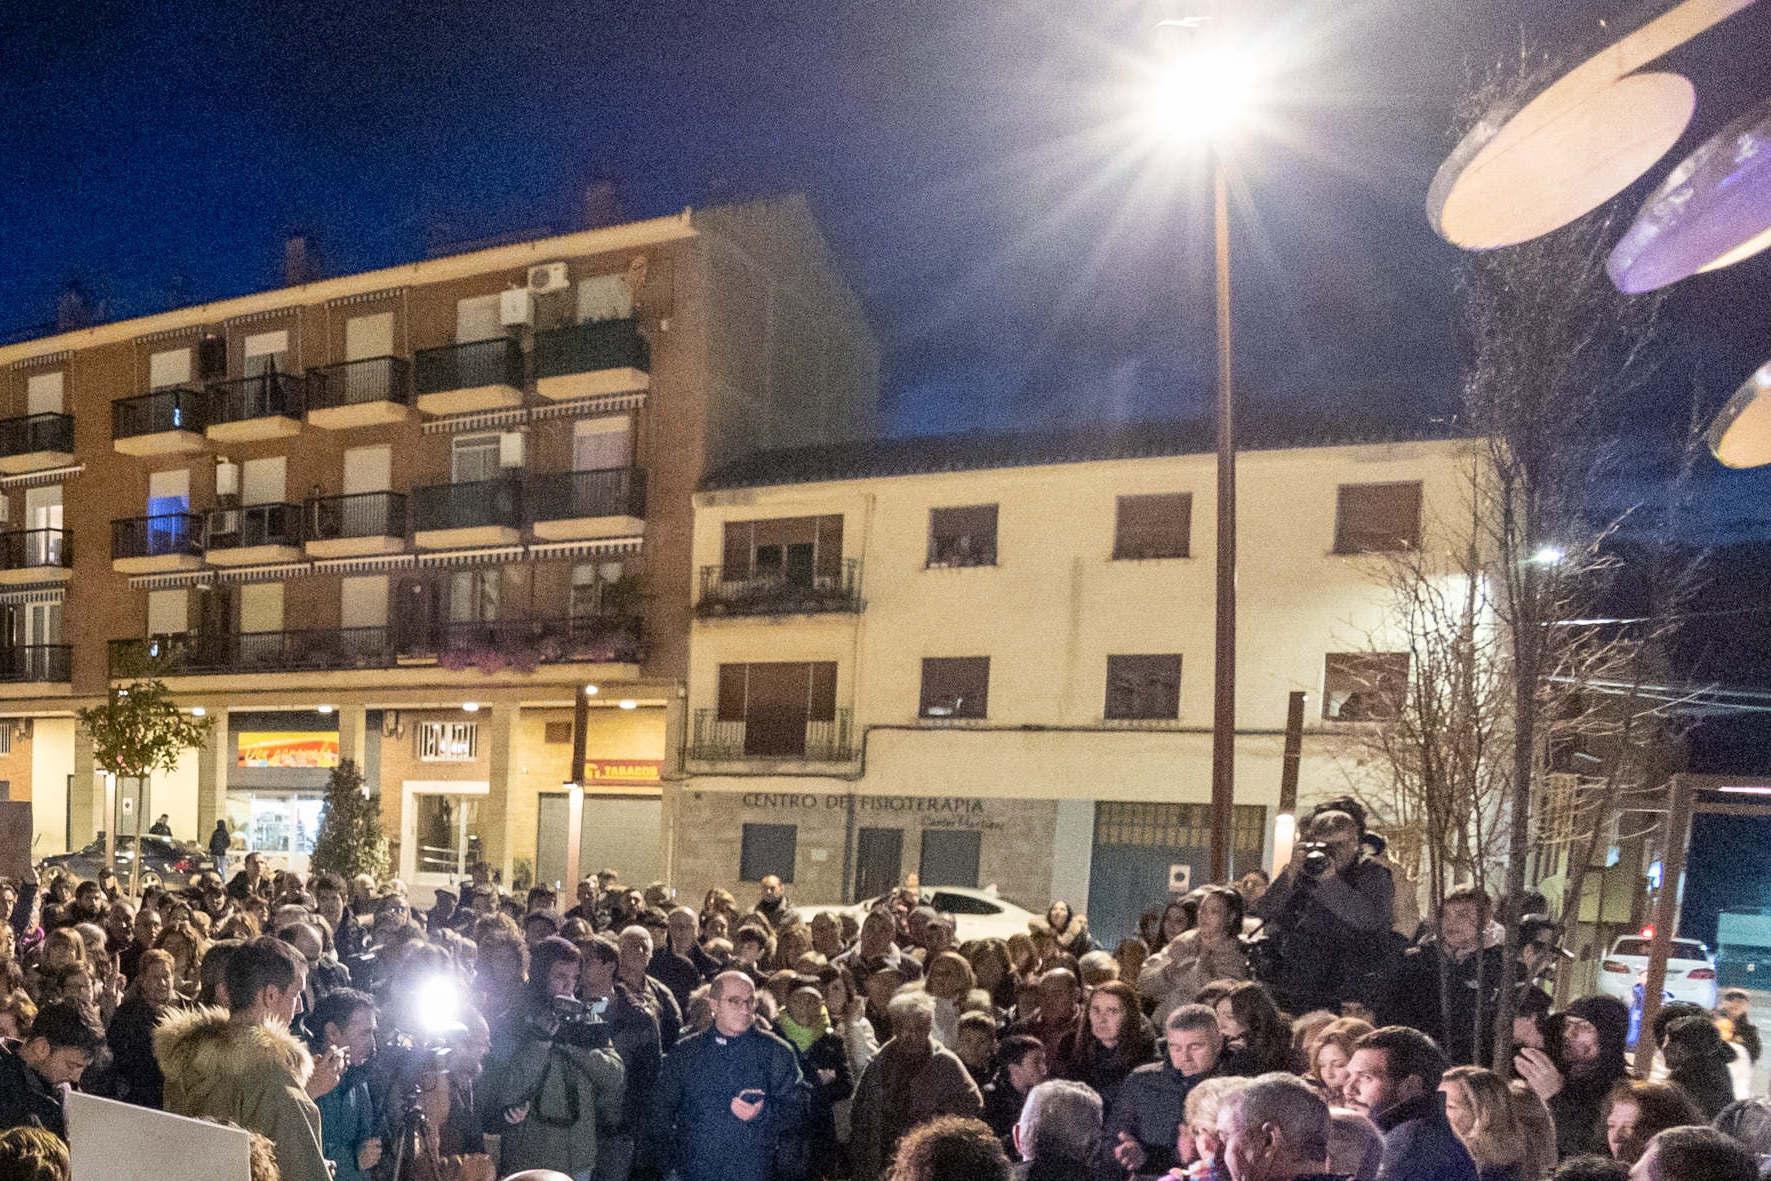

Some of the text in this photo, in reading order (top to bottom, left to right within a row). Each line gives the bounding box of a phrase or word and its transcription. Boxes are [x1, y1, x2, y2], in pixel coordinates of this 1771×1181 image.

[742, 792, 984, 813] CENTRO DE FISIOTERAPIA
